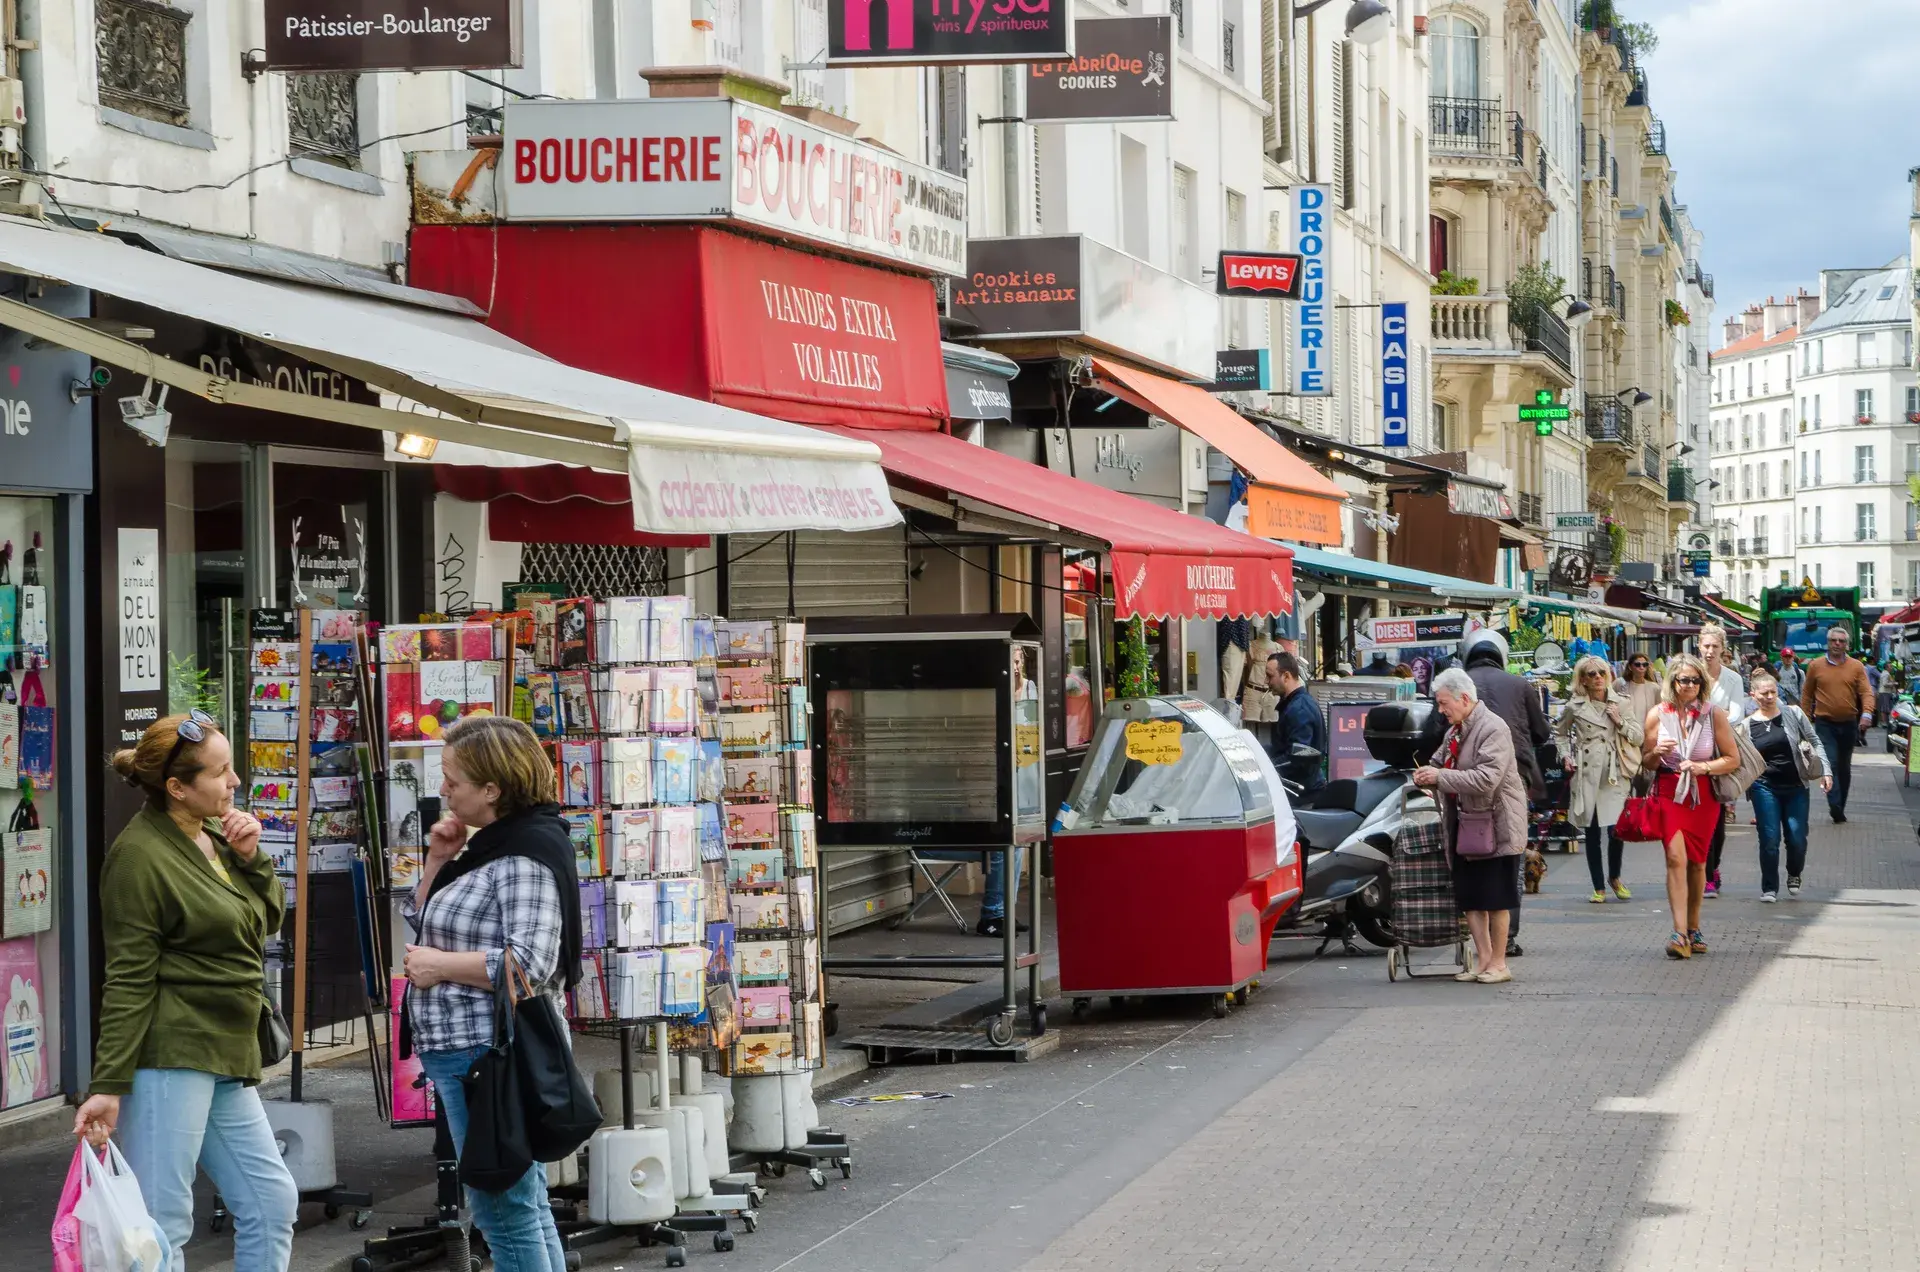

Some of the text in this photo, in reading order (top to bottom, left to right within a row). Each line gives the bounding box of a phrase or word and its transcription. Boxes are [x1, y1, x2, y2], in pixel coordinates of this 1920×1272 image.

[285, 6, 492, 43] Pâtissier-Boulanger
[933, 16, 1049, 36] vins spiritueux
[1058, 75, 1118, 90] COOKIES
[514, 136, 722, 185] BOUCHERIE
[736, 115, 904, 247] BOUCHERIE
[972, 270, 1057, 289] Cookies
[1299, 188, 1325, 392] DROGUERIE
[954, 288, 1077, 306] Artisanaux
[760, 279, 898, 342] VIANDES EXTRA
[791, 341, 883, 392] VOLAILLES
[1383, 316, 1407, 435] CASIO
[967, 379, 1012, 415] spiritueux
[1520, 408, 1568, 418] ORTHOPEDIE
[1556, 516, 1595, 528] MERCERIE
[123, 570, 155, 588] arnaud
[1186, 564, 1236, 591] BOUCHERIE
[123, 595, 156, 620] DEL
[123, 625, 156, 649] MON
[1376, 623, 1415, 639] DIESEL
[123, 654, 156, 679] TEL
[124, 707, 158, 722] HORAIRES
[1338, 716, 1358, 733] La
[120, 728, 136, 742] Tous
